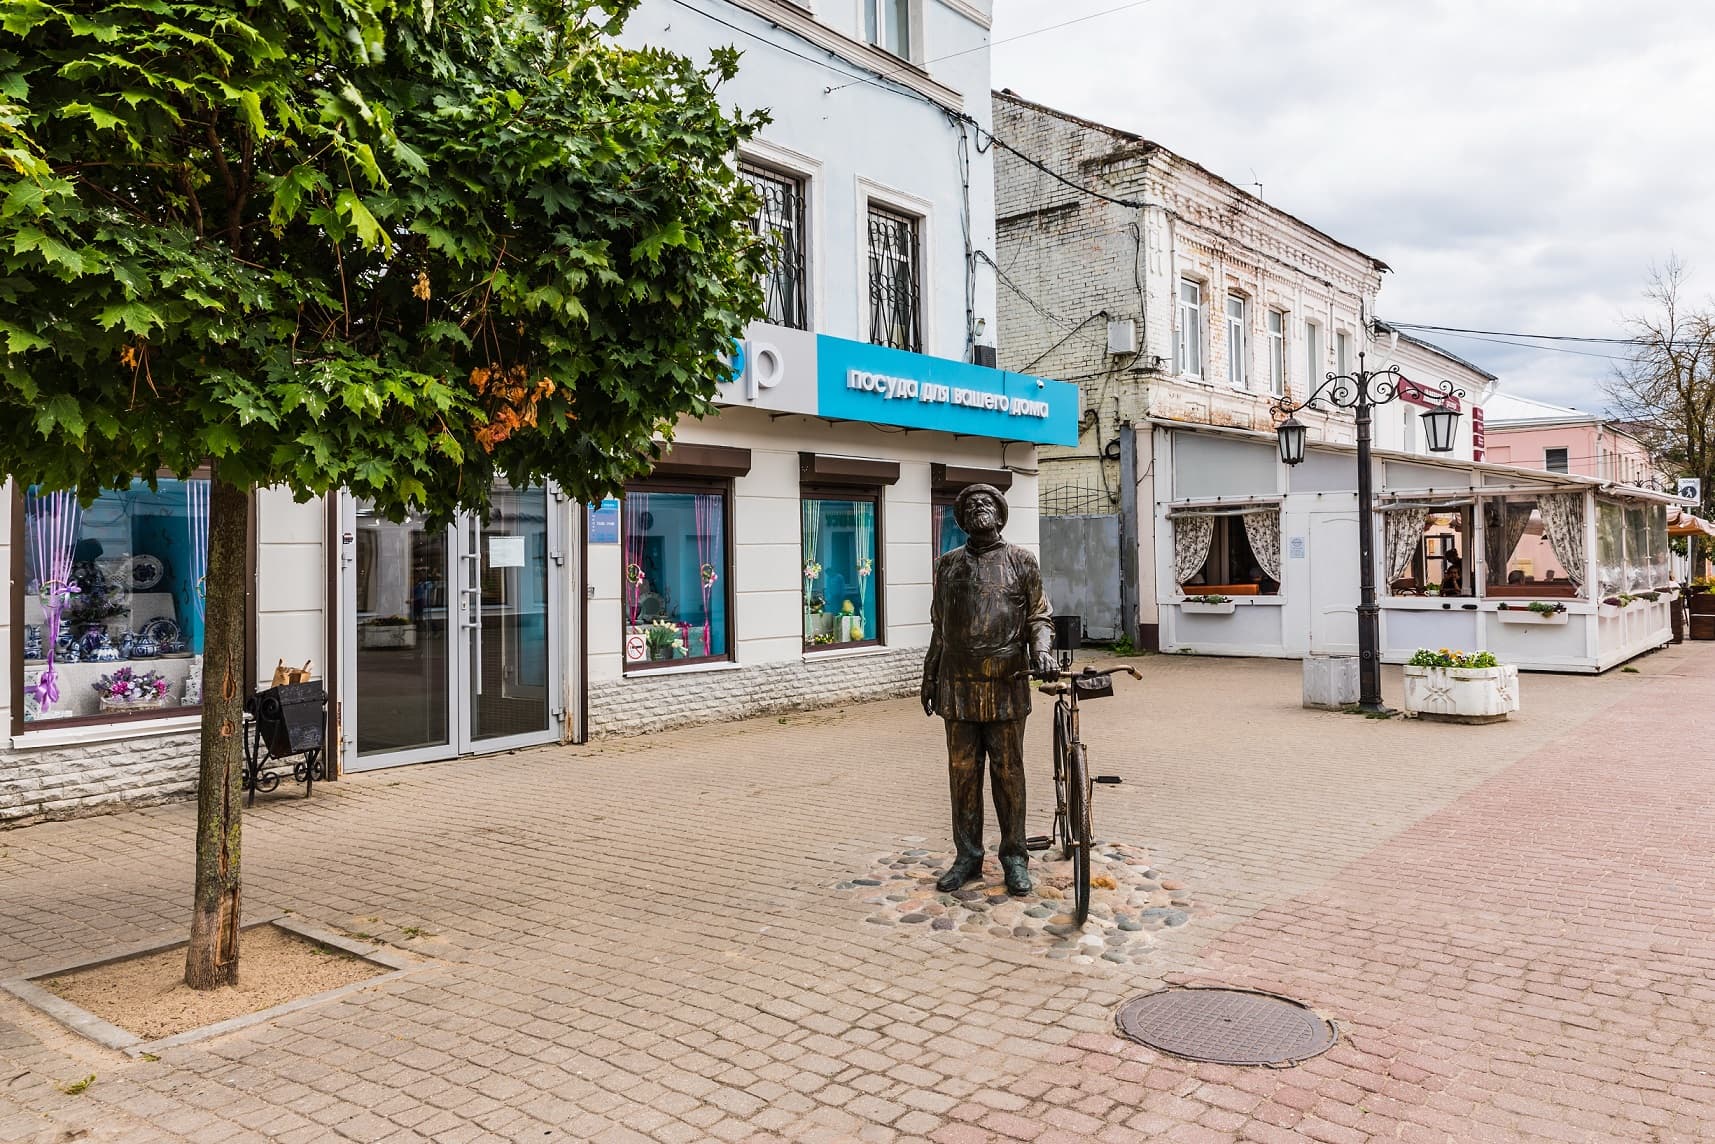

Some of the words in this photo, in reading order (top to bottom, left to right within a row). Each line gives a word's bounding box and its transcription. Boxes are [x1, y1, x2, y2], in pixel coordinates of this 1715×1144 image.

[846, 368, 919, 400] посуда
[919, 382, 950, 403] для
[950, 387, 1009, 412] вашего
[1008, 397, 1049, 418] дома
